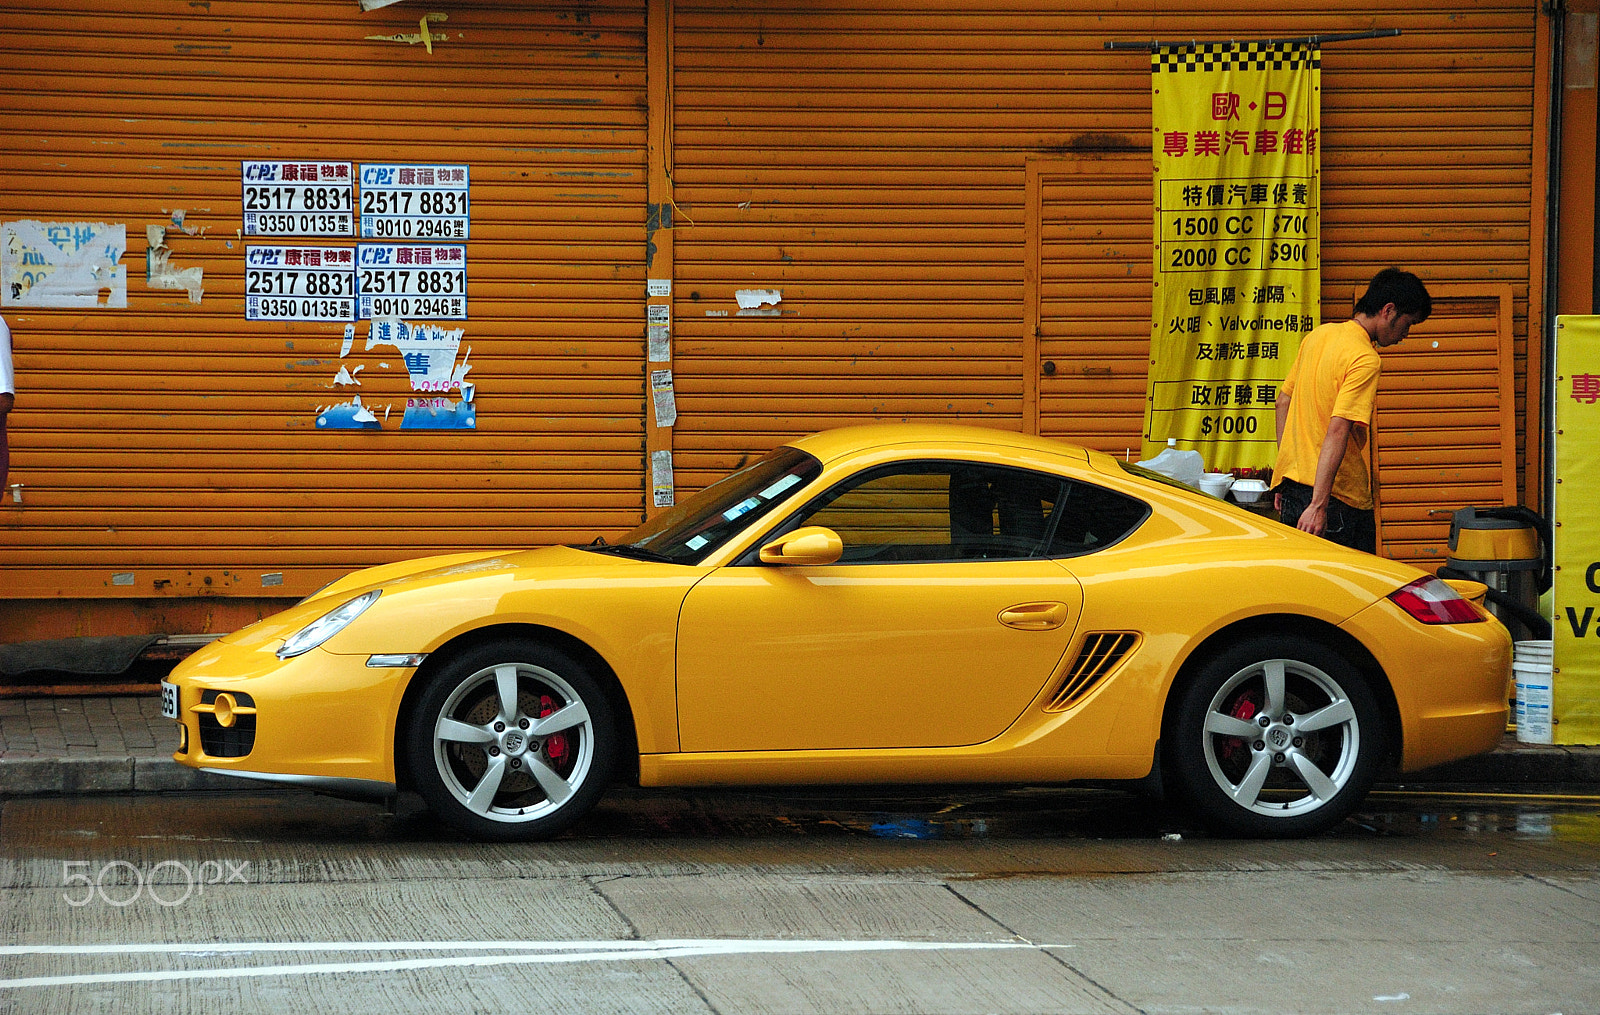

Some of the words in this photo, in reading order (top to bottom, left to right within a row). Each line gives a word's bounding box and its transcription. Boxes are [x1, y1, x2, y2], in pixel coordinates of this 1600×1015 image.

[246, 187, 296, 210] 2517
[303, 187, 351, 210] 8831
[363, 191, 413, 214] 2517
[420, 191, 467, 215] 8831
[1182, 184, 1308, 207] 特價汽車保養
[260, 215, 295, 232] 9350
[300, 215, 336, 232] 0135
[376, 219, 412, 237] 9010
[416, 219, 452, 237] 2946
[1172, 217, 1219, 236] 1500
[1225, 216, 1254, 234] CC
[1171, 247, 1217, 267] 2000
[1224, 246, 1252, 266] CC
[248, 271, 299, 294] 2517
[306, 272, 353, 296] 8831
[361, 270, 411, 293] 2517
[417, 270, 464, 294] 8831
[261, 299, 297, 317] 9350
[302, 300, 338, 318] 0135
[374, 298, 410, 316] 9010
[414, 298, 449, 316] 2946
[1196, 341, 1280, 361] 及清洗車頭
[1191, 384, 1277, 406] 政府驗車
[1201, 415, 1258, 436] $1000
[1565, 606, 1600, 638] V
